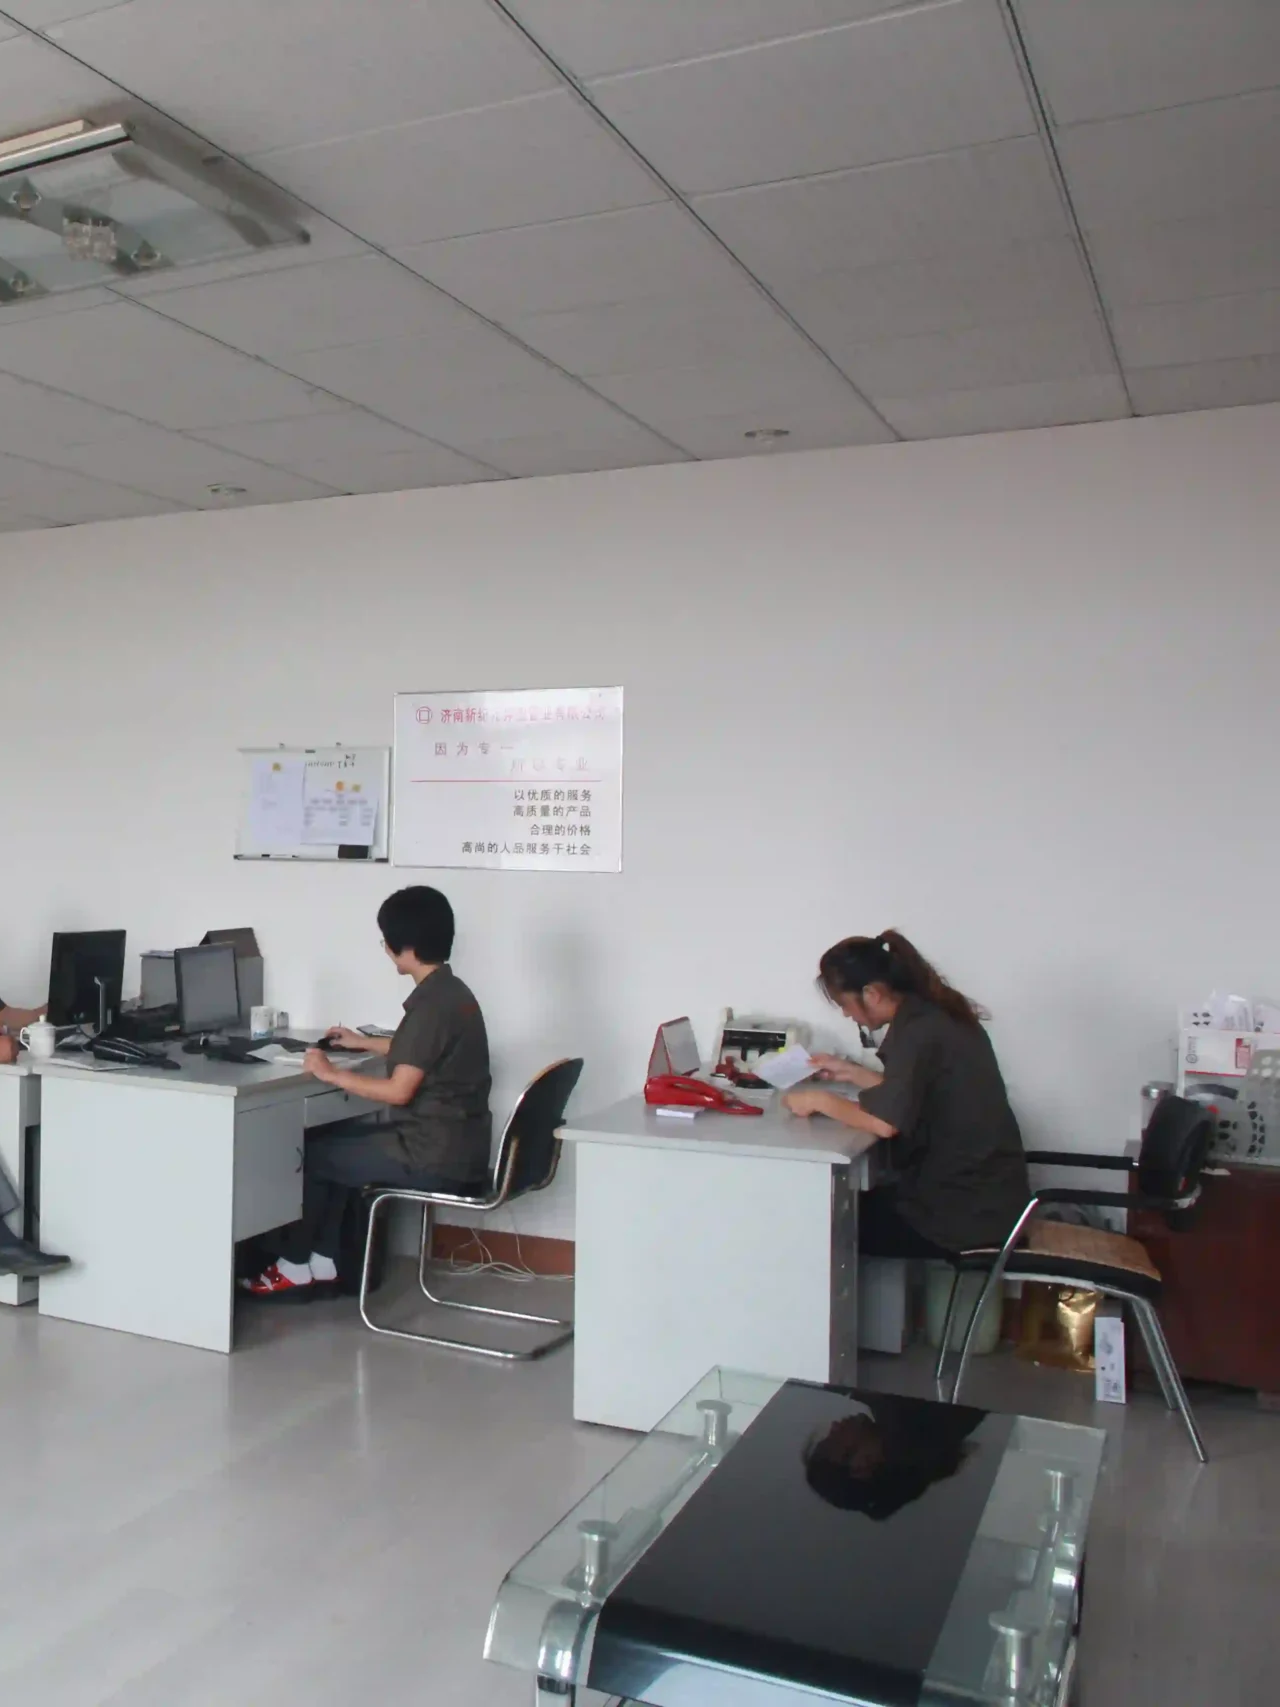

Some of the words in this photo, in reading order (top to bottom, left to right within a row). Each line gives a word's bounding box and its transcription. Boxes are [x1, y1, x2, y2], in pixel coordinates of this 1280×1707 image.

[514, 789, 592, 802] 以优质的服务
[512, 805, 592, 818] 高质量的产品
[530, 824, 592, 837] 合理的价格
